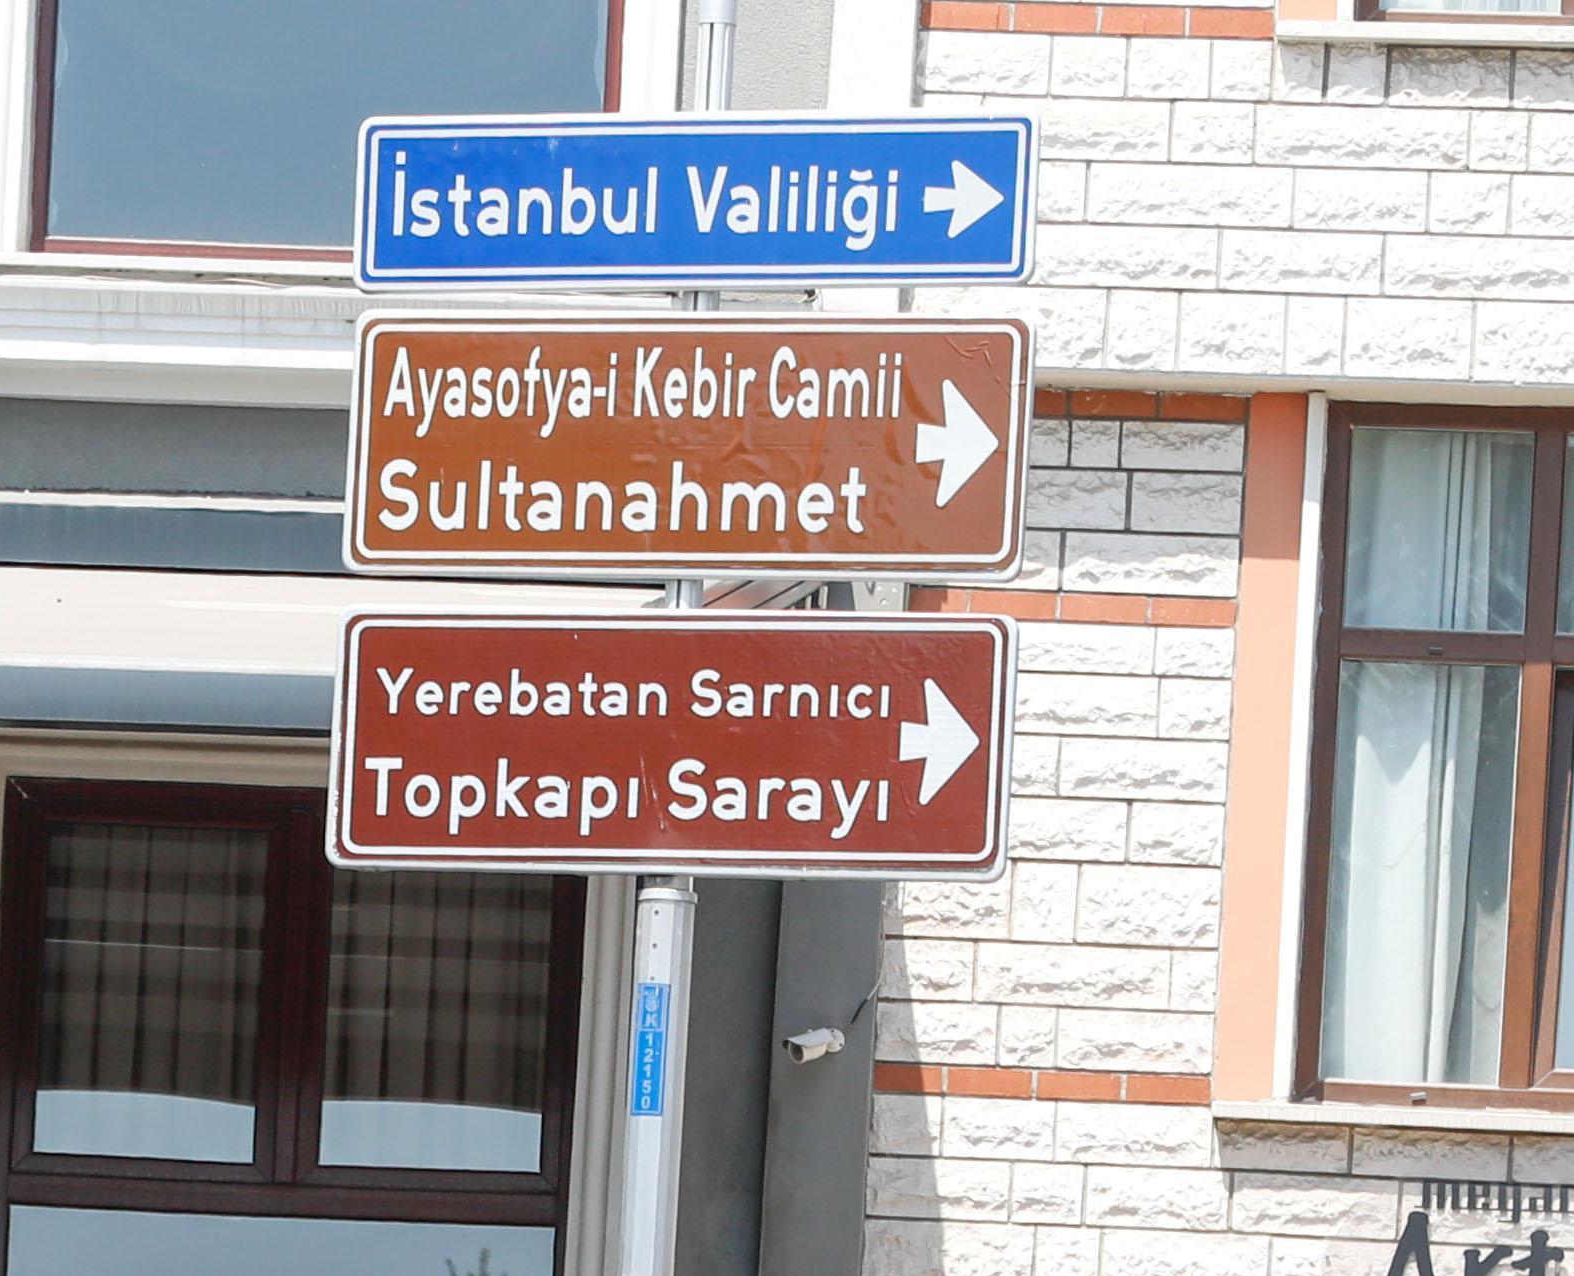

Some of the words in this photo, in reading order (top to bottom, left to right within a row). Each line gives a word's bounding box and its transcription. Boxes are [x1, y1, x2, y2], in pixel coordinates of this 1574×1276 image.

[391, 150, 658, 238] İstanbul
[687, 163, 900, 251] Valiliği
[383, 346, 618, 437] Ayasofya-i
[634, 346, 756, 420] Kebir
[769, 346, 903, 420] Camii
[378, 458, 867, 534] Sultanahmet
[377, 666, 669, 719] Yerebatan
[690, 669, 891, 720] Sarnıcı
[364, 756, 640, 837] Topkapı
[666, 758, 890, 839] Sarayı
[640, 1033, 655, 1110] 12150
